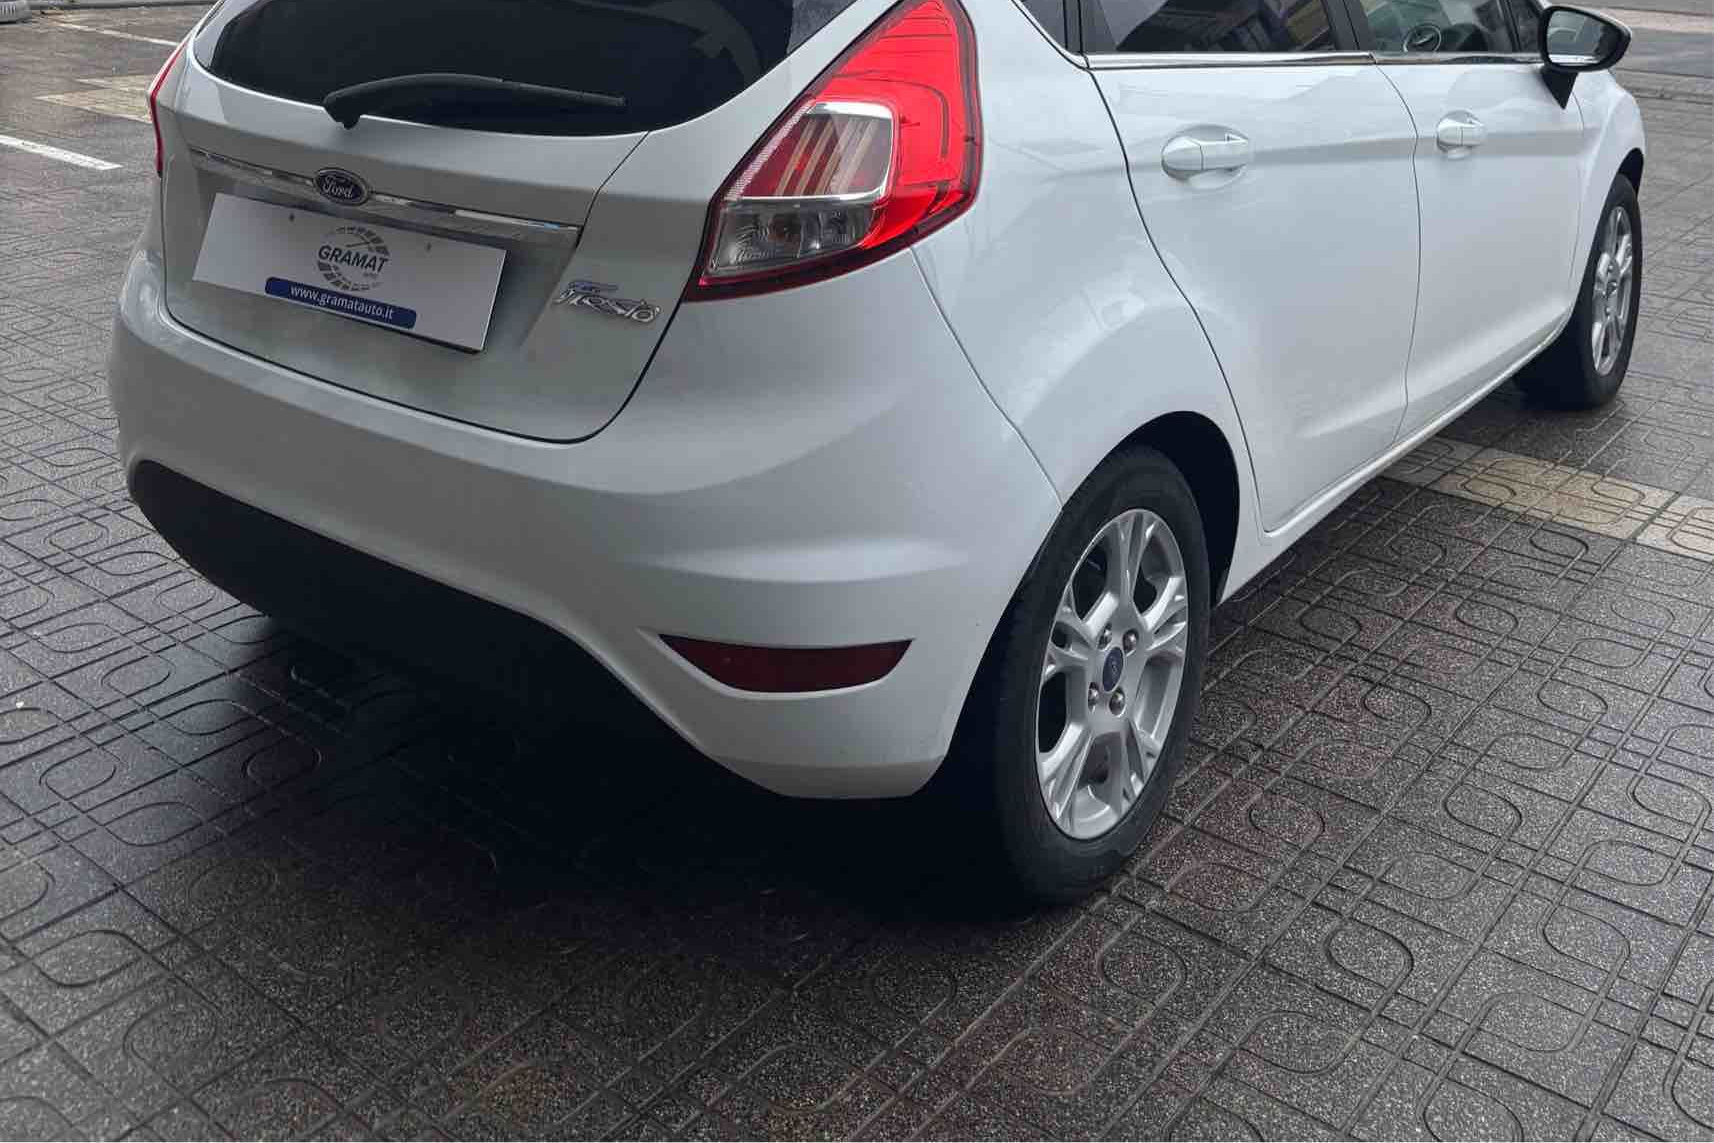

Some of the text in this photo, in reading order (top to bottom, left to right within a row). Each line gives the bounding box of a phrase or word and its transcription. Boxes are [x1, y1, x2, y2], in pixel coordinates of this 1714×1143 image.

[322, 175, 353, 199] Ford
[318, 244, 389, 274] GRAMAT
[290, 285, 394, 320] www.gramatauto.it
